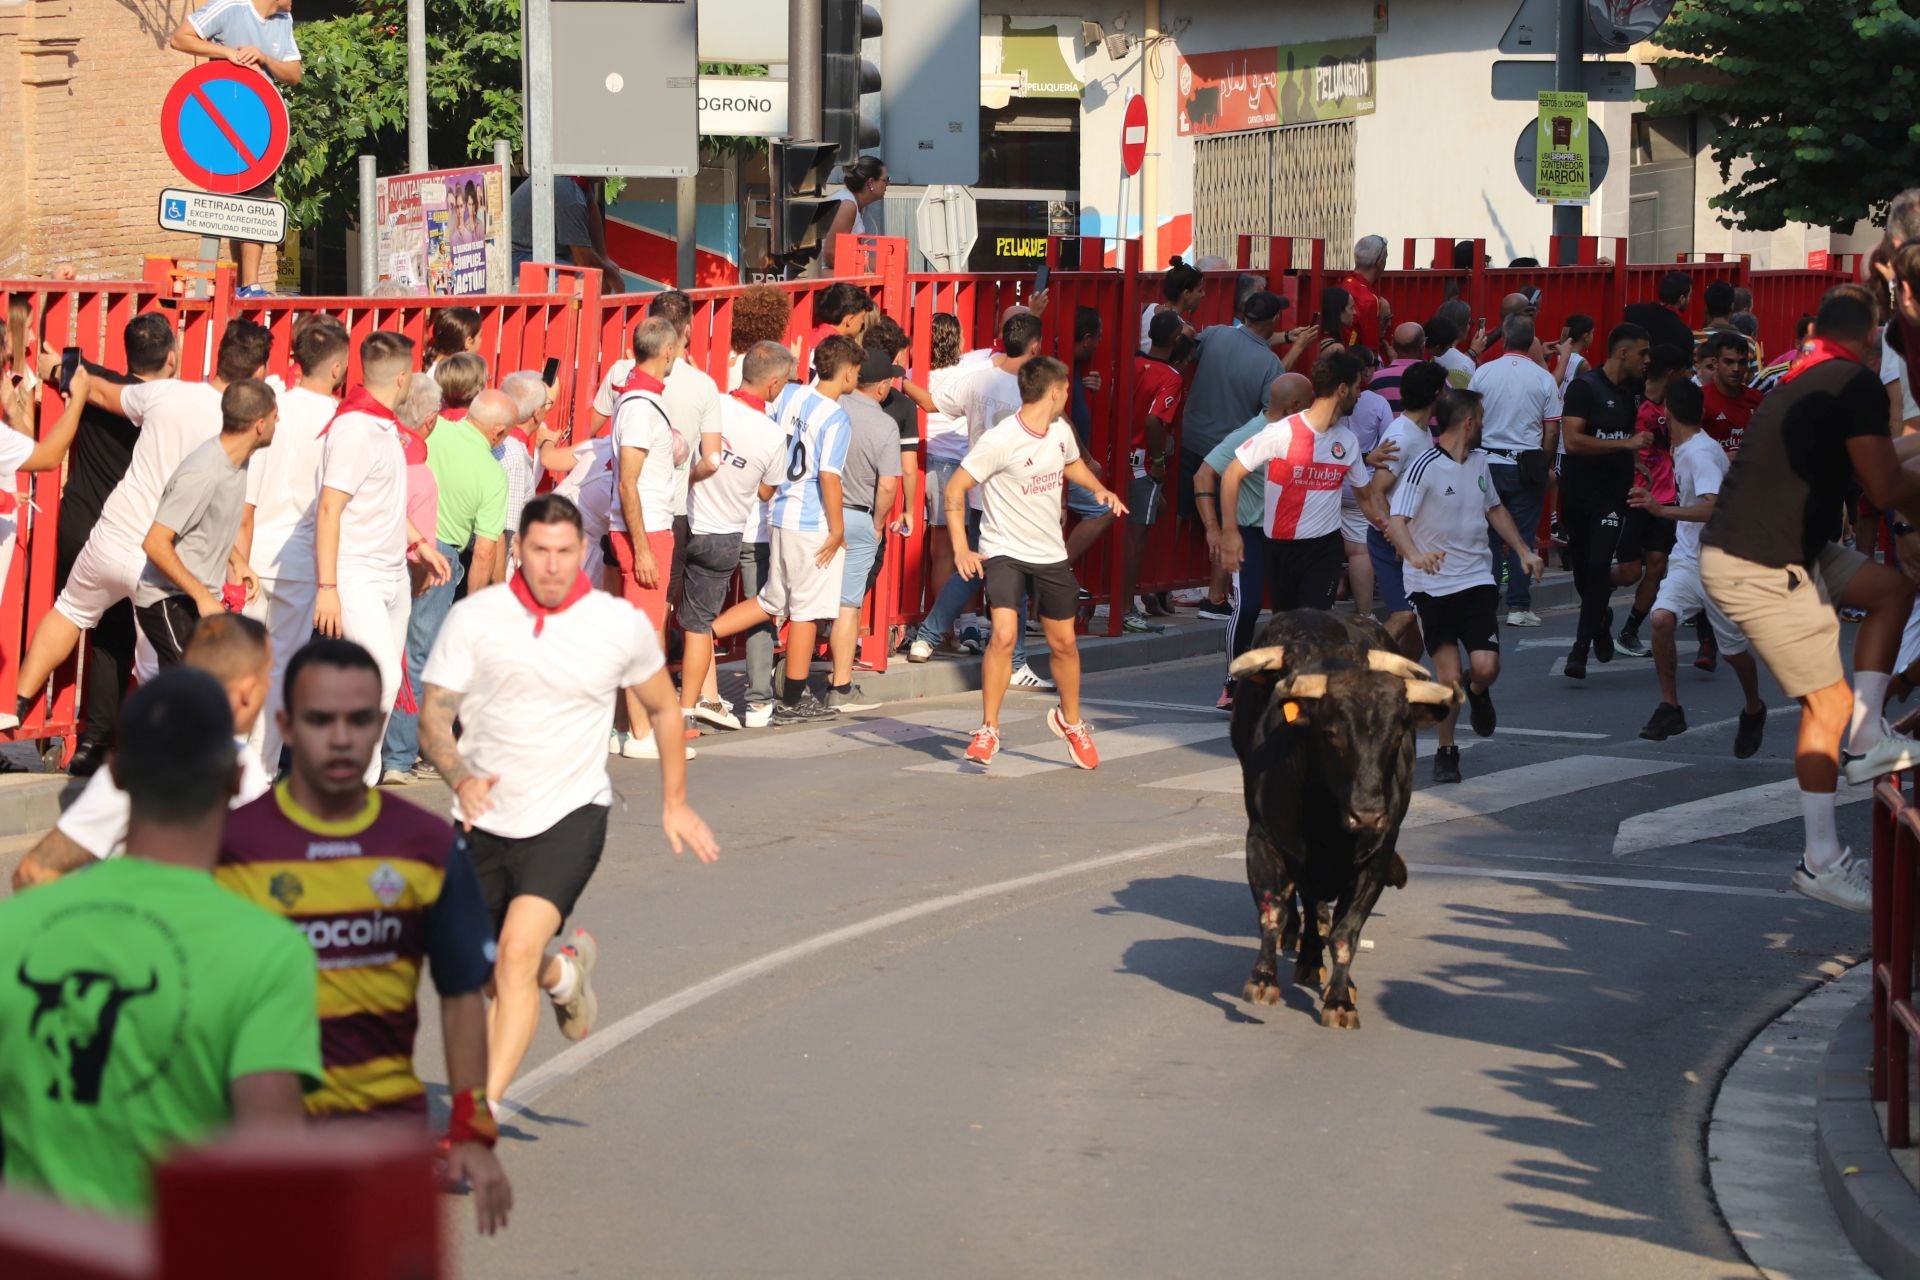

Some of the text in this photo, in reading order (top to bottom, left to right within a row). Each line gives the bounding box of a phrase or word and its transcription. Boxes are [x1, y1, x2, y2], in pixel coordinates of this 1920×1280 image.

[1027, 82, 1079, 92] PELUQUERÍA
[1564, 100, 1584, 108] COMIDA
[1551, 153, 1576, 161] SIEMPRE
[1540, 160, 1584, 170] CONTENEDOR
[193, 198, 244, 213] RETIRADA
[190, 209, 278, 227] EXCEPTO ACREDITADOS
[198, 221, 240, 232] MOVILIDAD
[241, 226, 279, 237] REDUCIDA
[1031, 471, 1057, 486] Team
[1021, 481, 1056, 496] Viewer
